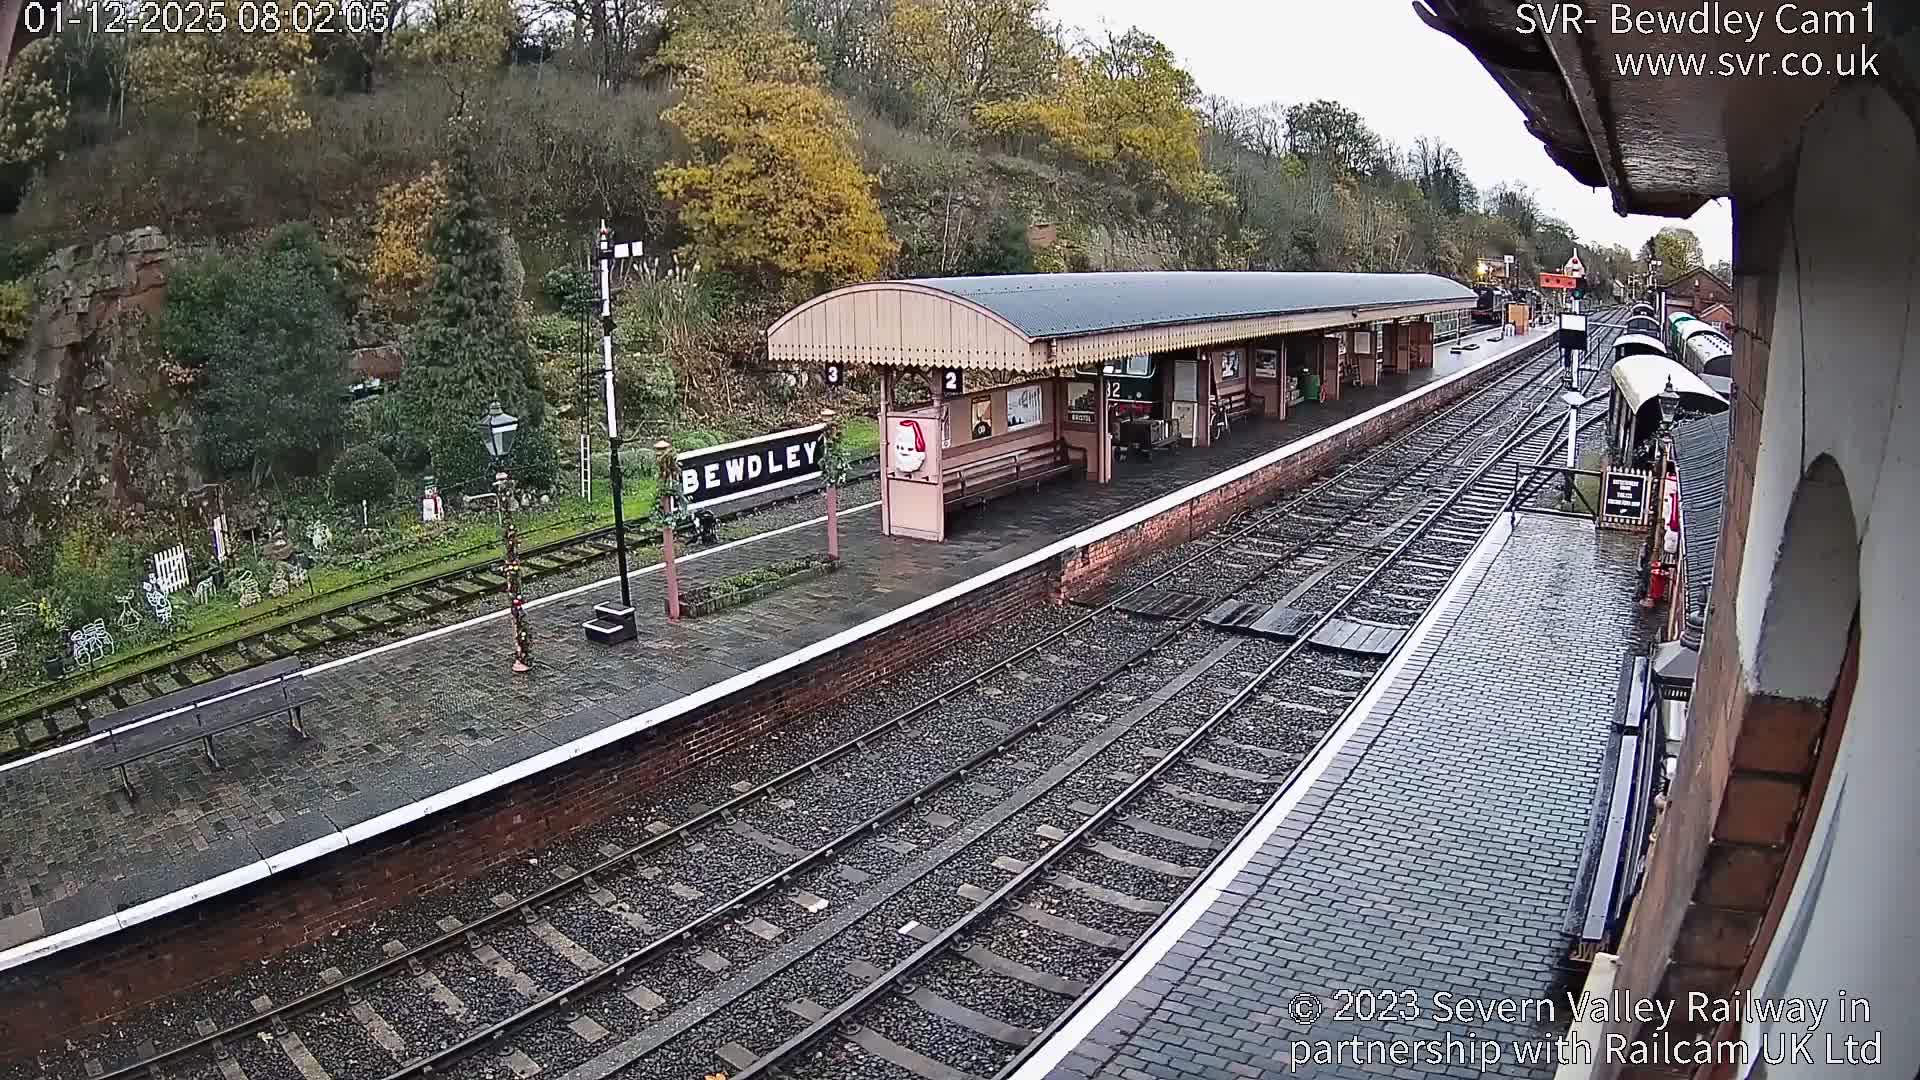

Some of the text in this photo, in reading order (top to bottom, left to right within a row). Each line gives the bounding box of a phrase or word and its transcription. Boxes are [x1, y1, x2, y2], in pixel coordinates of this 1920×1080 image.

[828, 366, 838, 383] 3
[945, 371, 957, 389] 2
[681, 440, 817, 495] BEWDLEY
